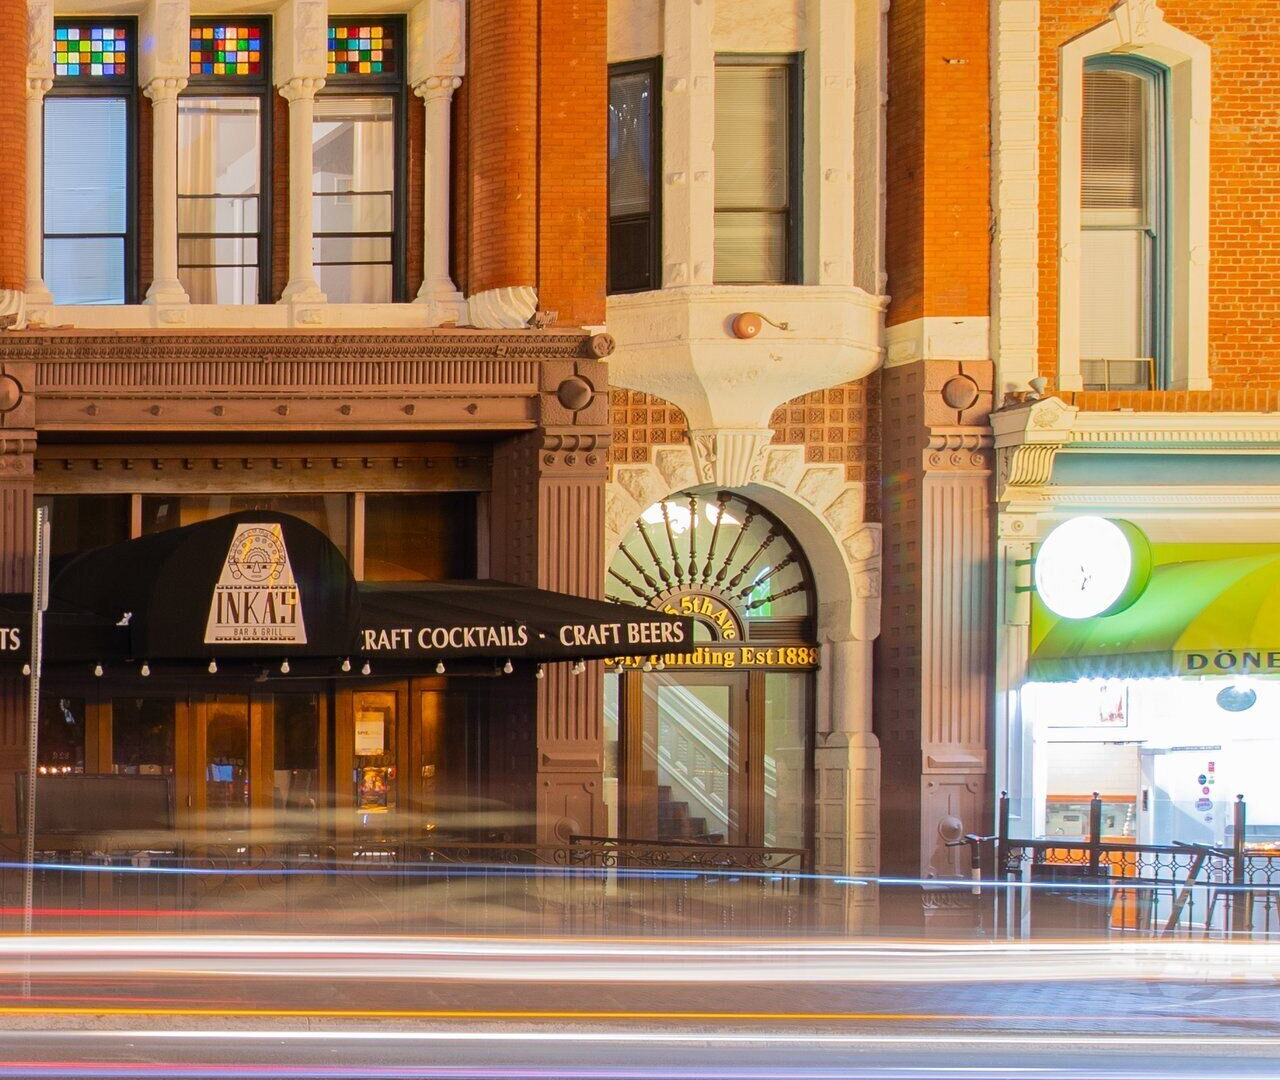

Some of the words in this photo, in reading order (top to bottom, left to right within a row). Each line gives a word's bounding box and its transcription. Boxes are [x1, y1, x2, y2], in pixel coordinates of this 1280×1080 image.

[680, 595, 713, 617] 5th
[710, 607, 736, 640] Ave
[233, 627, 249, 636] BAR
[253, 627, 258, 636] &
[261, 627, 283, 636] GRILL
[417, 625, 528, 649] COCKTAILS
[559, 623, 621, 647] CRAFT
[627, 621, 684, 644] BEERS
[740, 647, 775, 665] Est
[777, 647, 819, 665] 1888
